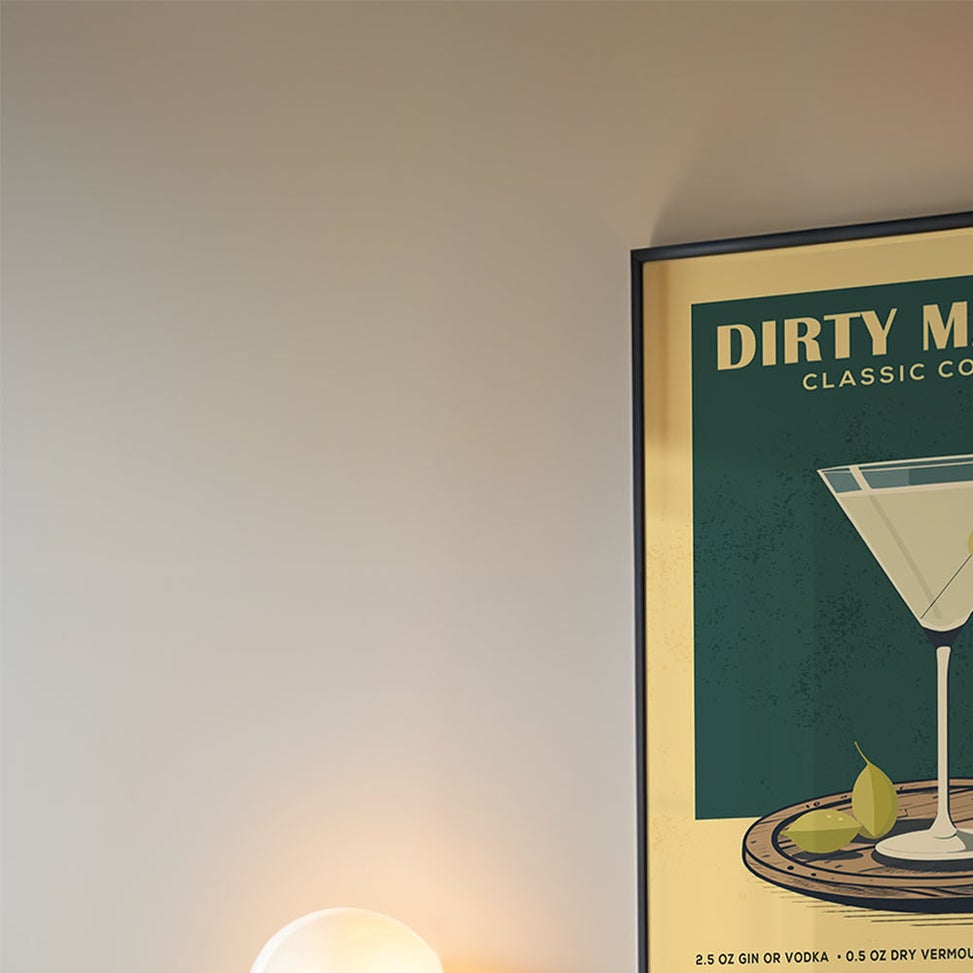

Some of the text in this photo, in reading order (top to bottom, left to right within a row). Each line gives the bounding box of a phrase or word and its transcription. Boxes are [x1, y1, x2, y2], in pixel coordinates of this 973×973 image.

[717, 308, 898, 371] DIRTY
[802, 363, 925, 391] CLASSIC
[696, 954, 715, 965] 2.5
[718, 953, 735, 965] OZ
[738, 952, 759, 964] GIN
[763, 952, 781, 963] OR
[785, 951, 829, 963] VODKA
[846, 949, 866, 962] 0.5
[869, 949, 887, 962] OZ
[891, 949, 917, 961] DRY
